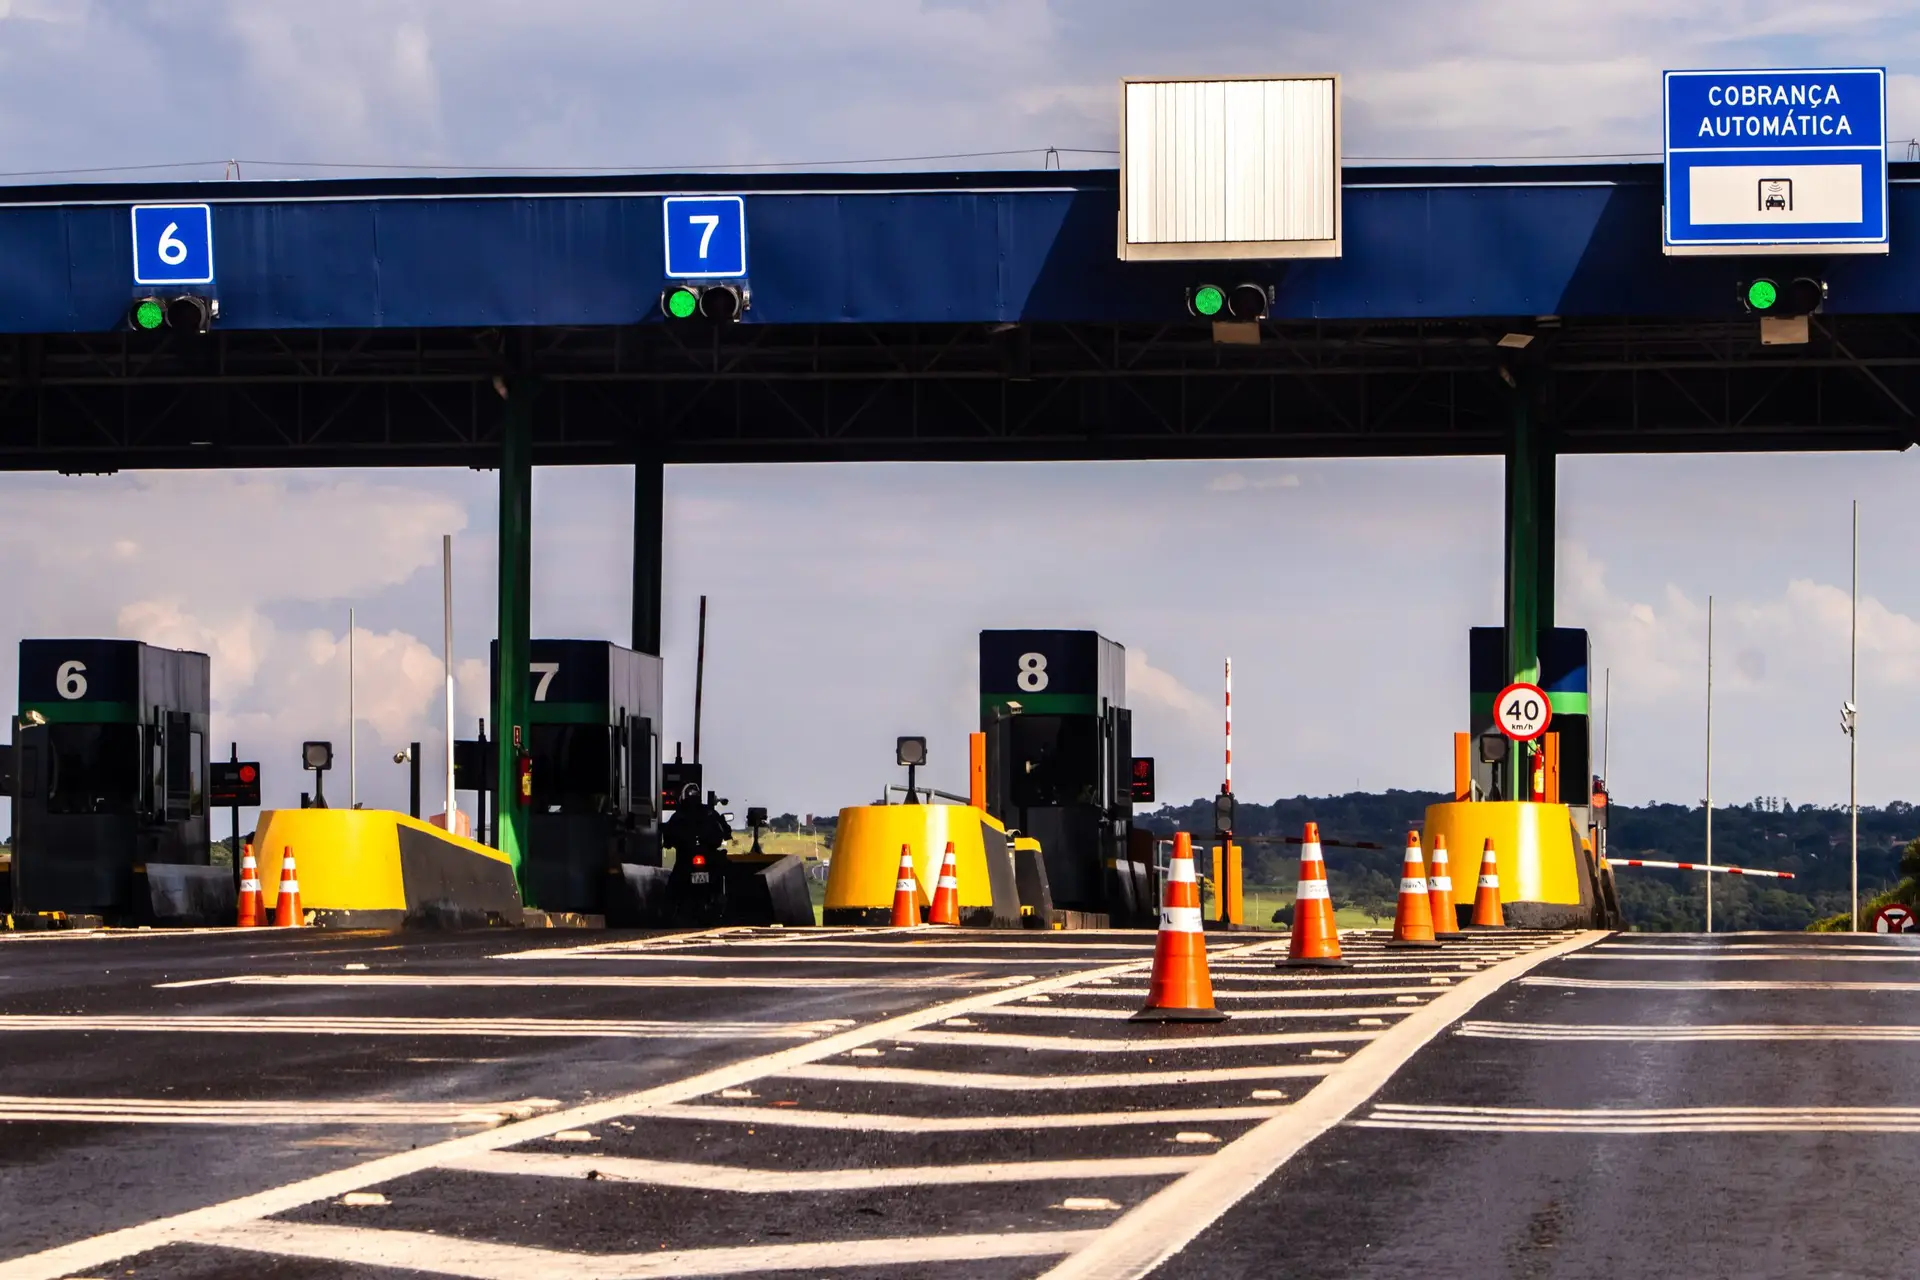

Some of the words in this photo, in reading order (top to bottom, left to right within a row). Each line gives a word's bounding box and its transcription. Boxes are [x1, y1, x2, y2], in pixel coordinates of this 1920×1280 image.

[1708, 84, 1841, 109] COBRANÇA
[1698, 109, 1852, 137] AUTOMÁTICA
[157, 221, 188, 266] 6
[689, 214, 720, 259] 7
[56, 660, 88, 700] 6
[529, 662, 560, 702] 7
[1016, 652, 1049, 691] 8
[1506, 699, 1539, 721] 40
